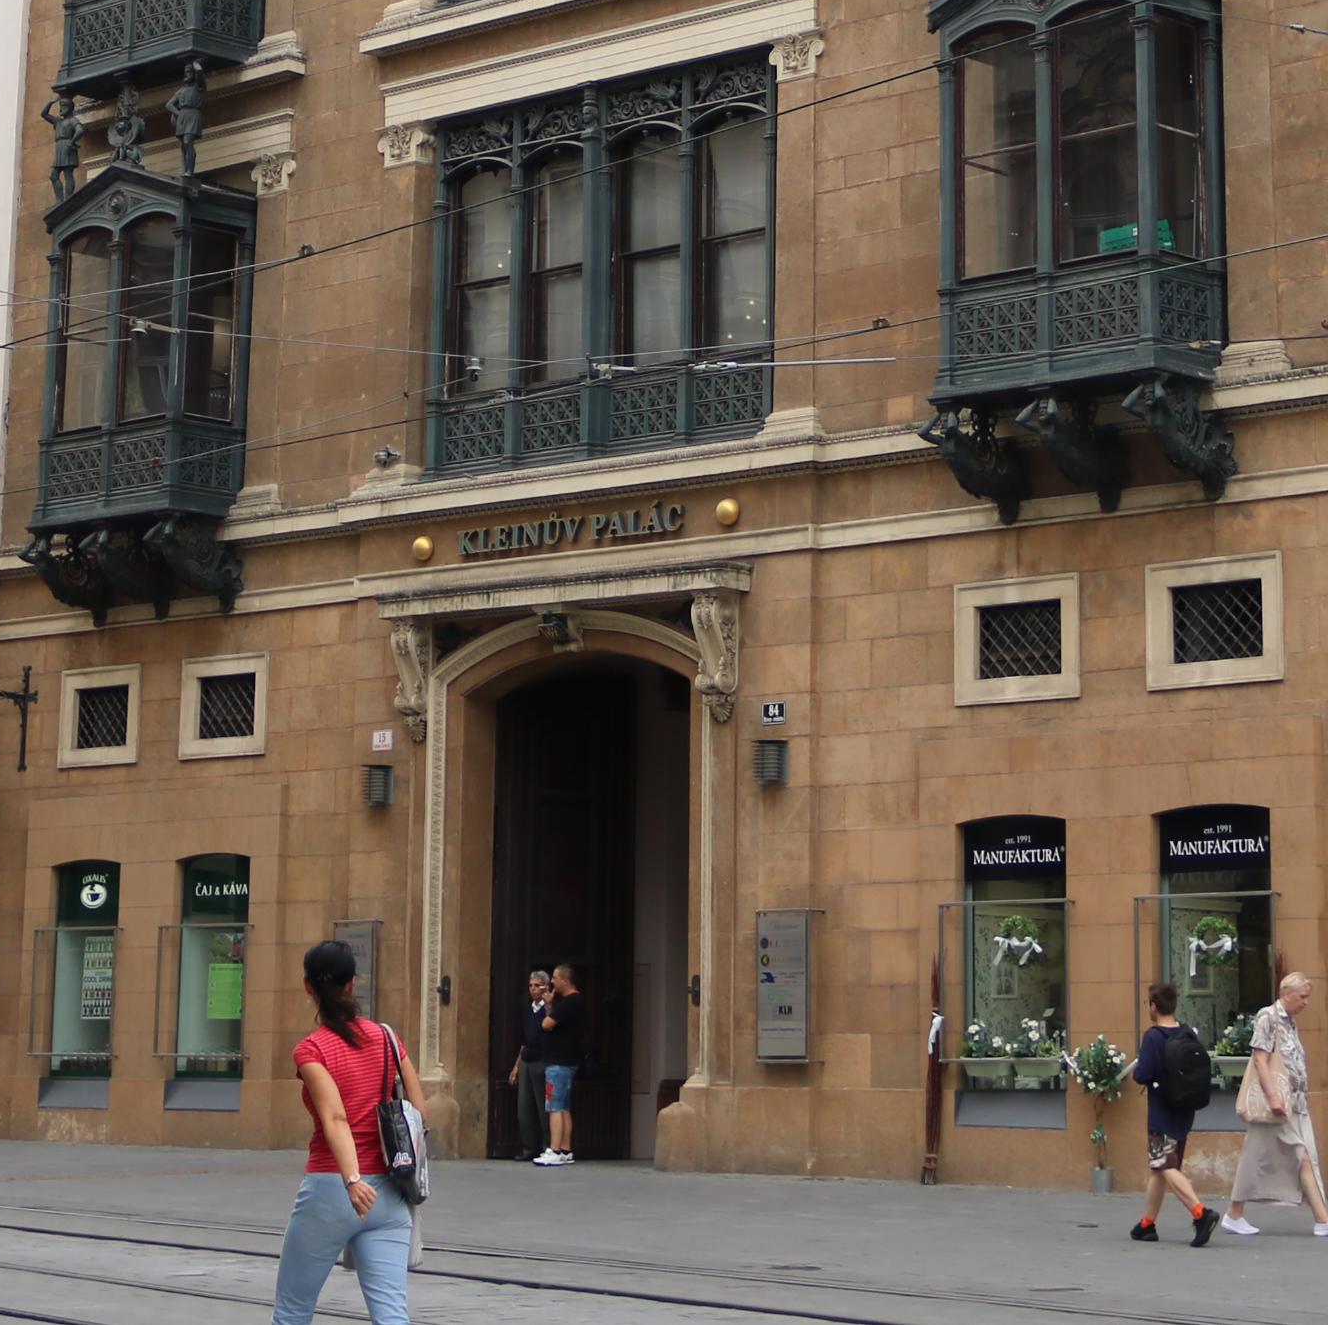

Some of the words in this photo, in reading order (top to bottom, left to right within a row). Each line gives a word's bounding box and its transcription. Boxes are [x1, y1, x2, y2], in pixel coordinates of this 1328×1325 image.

[457, 511, 582, 555] KLEINŮV
[588, 500, 686, 540] PALÁC
[768, 704, 779, 716] 84
[1216, 824, 1232, 834] 1991
[1016, 835, 1031, 844] 1991
[195, 882, 212, 897] ČAJ
[214, 885, 220, 896] &
[222, 881, 248, 896] KÁVA
